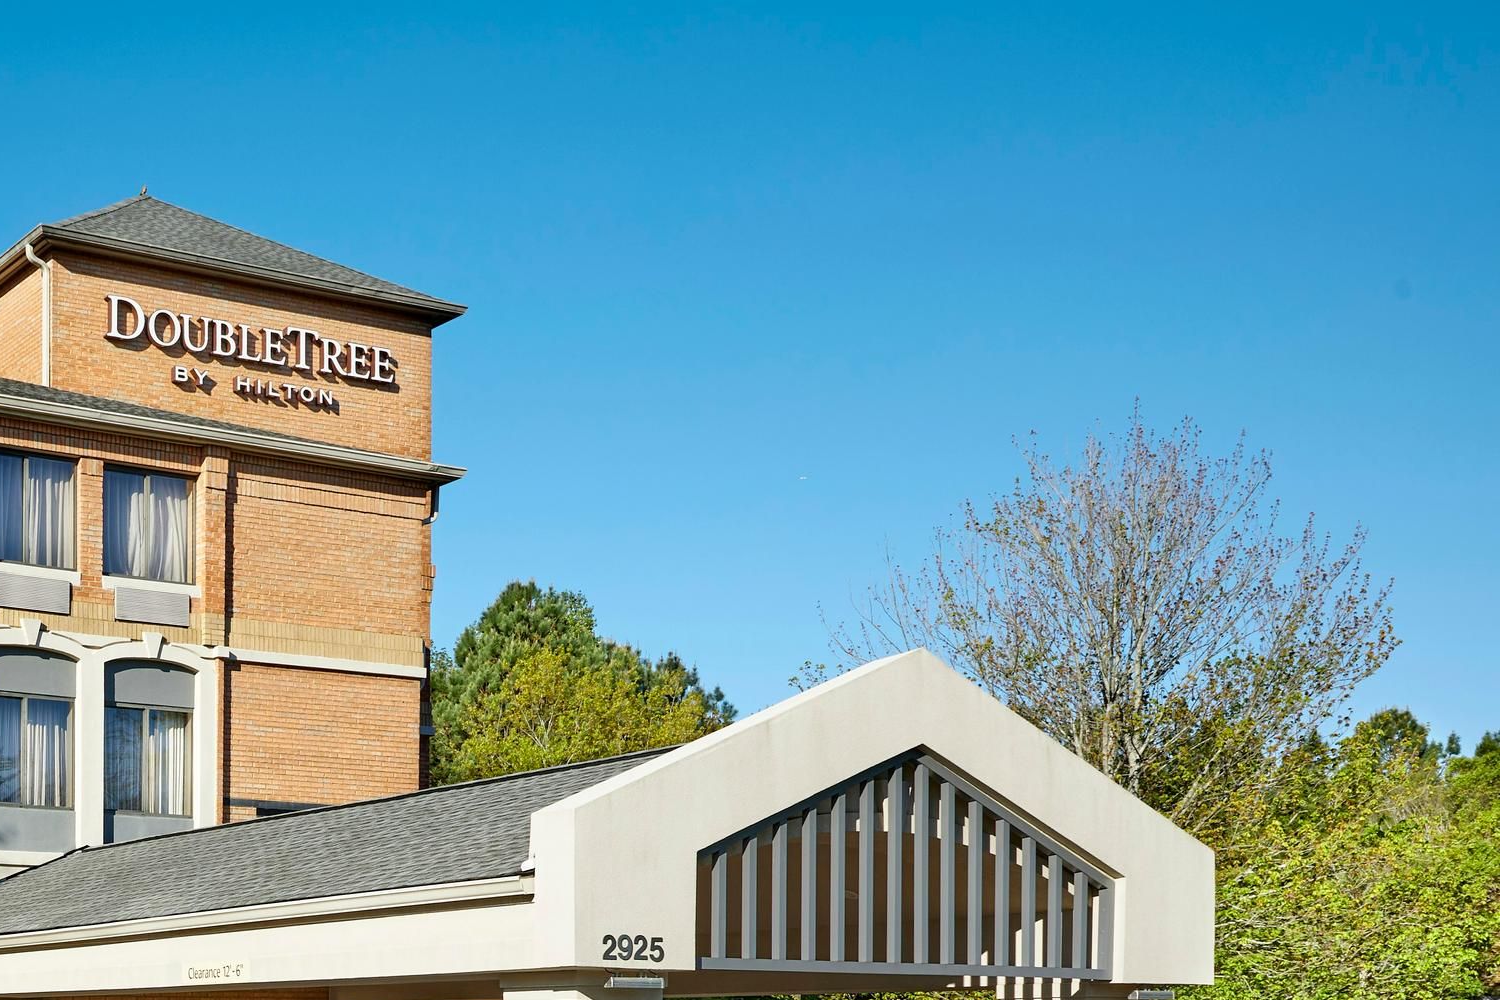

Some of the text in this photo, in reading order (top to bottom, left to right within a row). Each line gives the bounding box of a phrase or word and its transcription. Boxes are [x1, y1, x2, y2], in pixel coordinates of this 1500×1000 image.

[105, 293, 395, 384] DOUBLETREE
[172, 365, 334, 406] BY HILTON
[602, 934, 665, 963] 2925
[187, 967, 221, 980] Clearance
